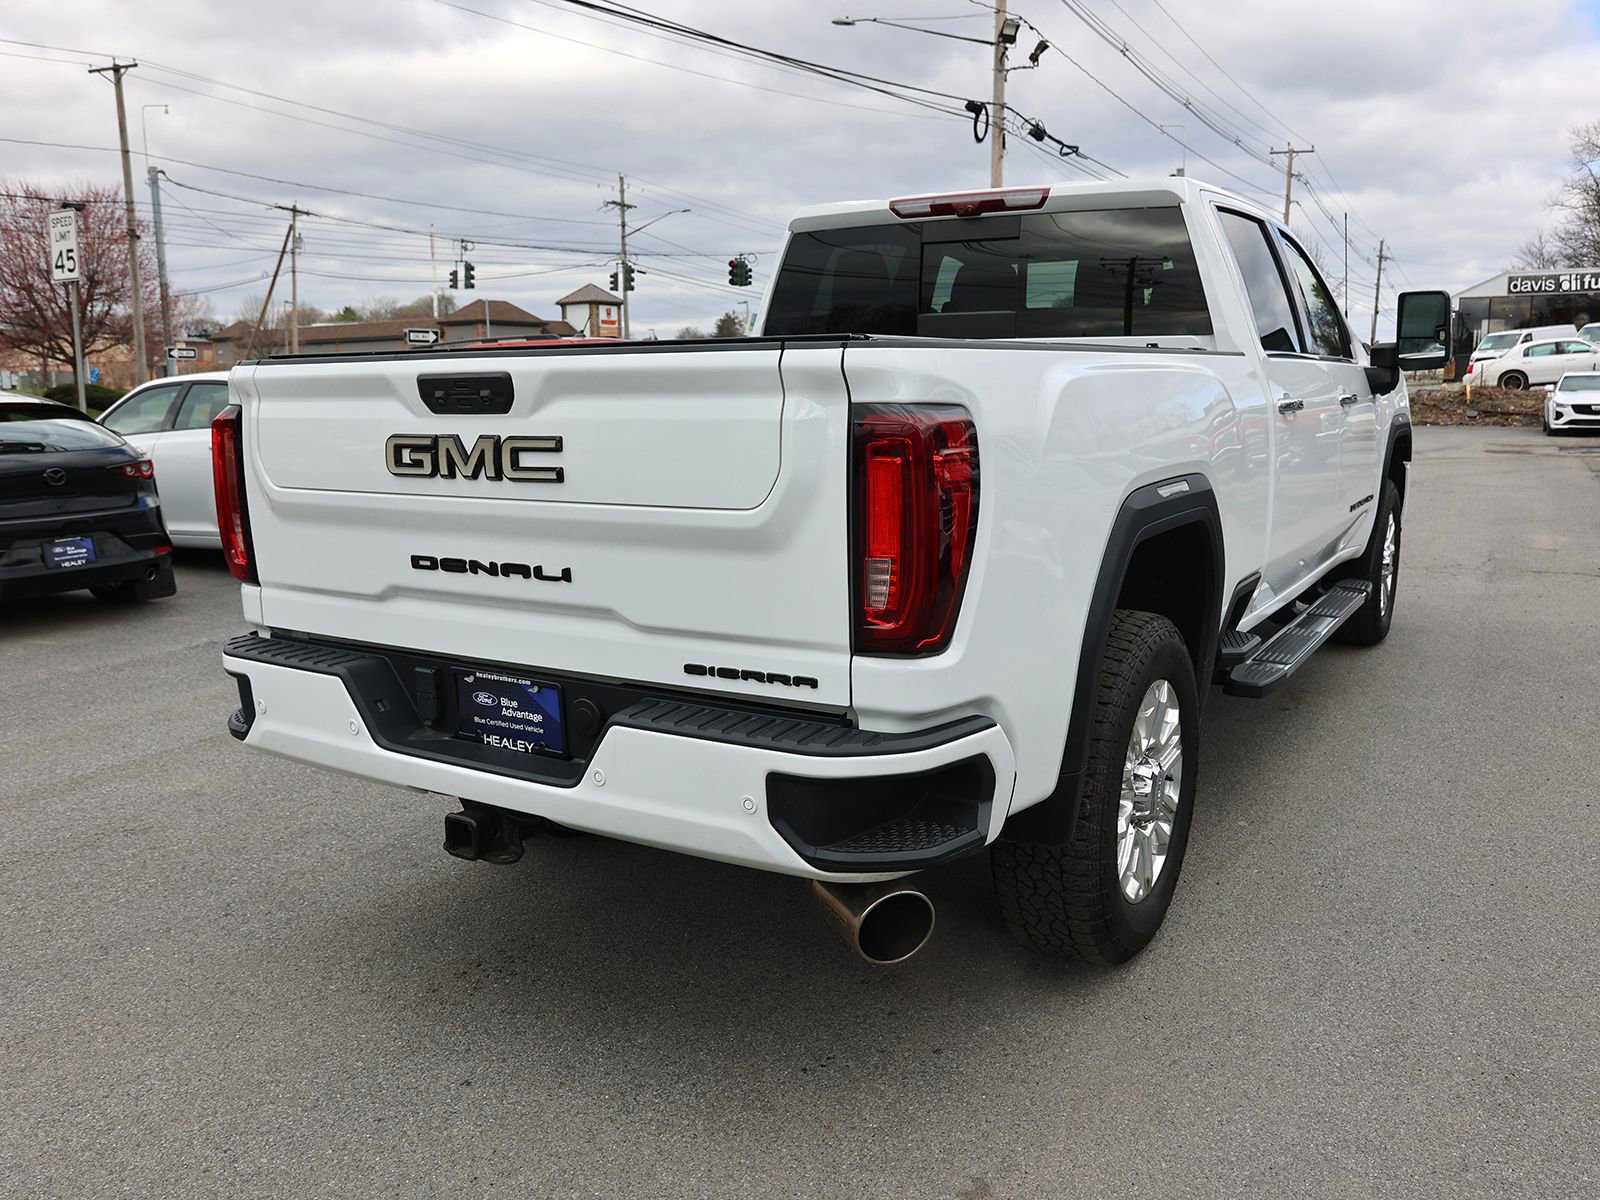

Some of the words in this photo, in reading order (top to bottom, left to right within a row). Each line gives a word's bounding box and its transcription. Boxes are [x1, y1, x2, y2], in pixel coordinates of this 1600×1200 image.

[51, 215, 73, 228] SPEED
[54, 230, 71, 243] LIMIT
[54, 248, 77, 273] 45
[1509, 277, 1556, 293] davis
[385, 433, 565, 483] GMC
[410, 554, 573, 584] DENALI
[475, 671, 532, 686] healeybrothers.com
[683, 663, 819, 690] SIERRA
[476, 693, 493, 705] Ford
[500, 697, 519, 708] Blue
[501, 707, 544, 722] Advantage
[473, 716, 486, 724] Blue
[486, 718, 509, 728] Certified
[509, 722, 524, 731] Used
[524, 725, 545, 735] Vehicle
[483, 733, 535, 753] HEALEY
